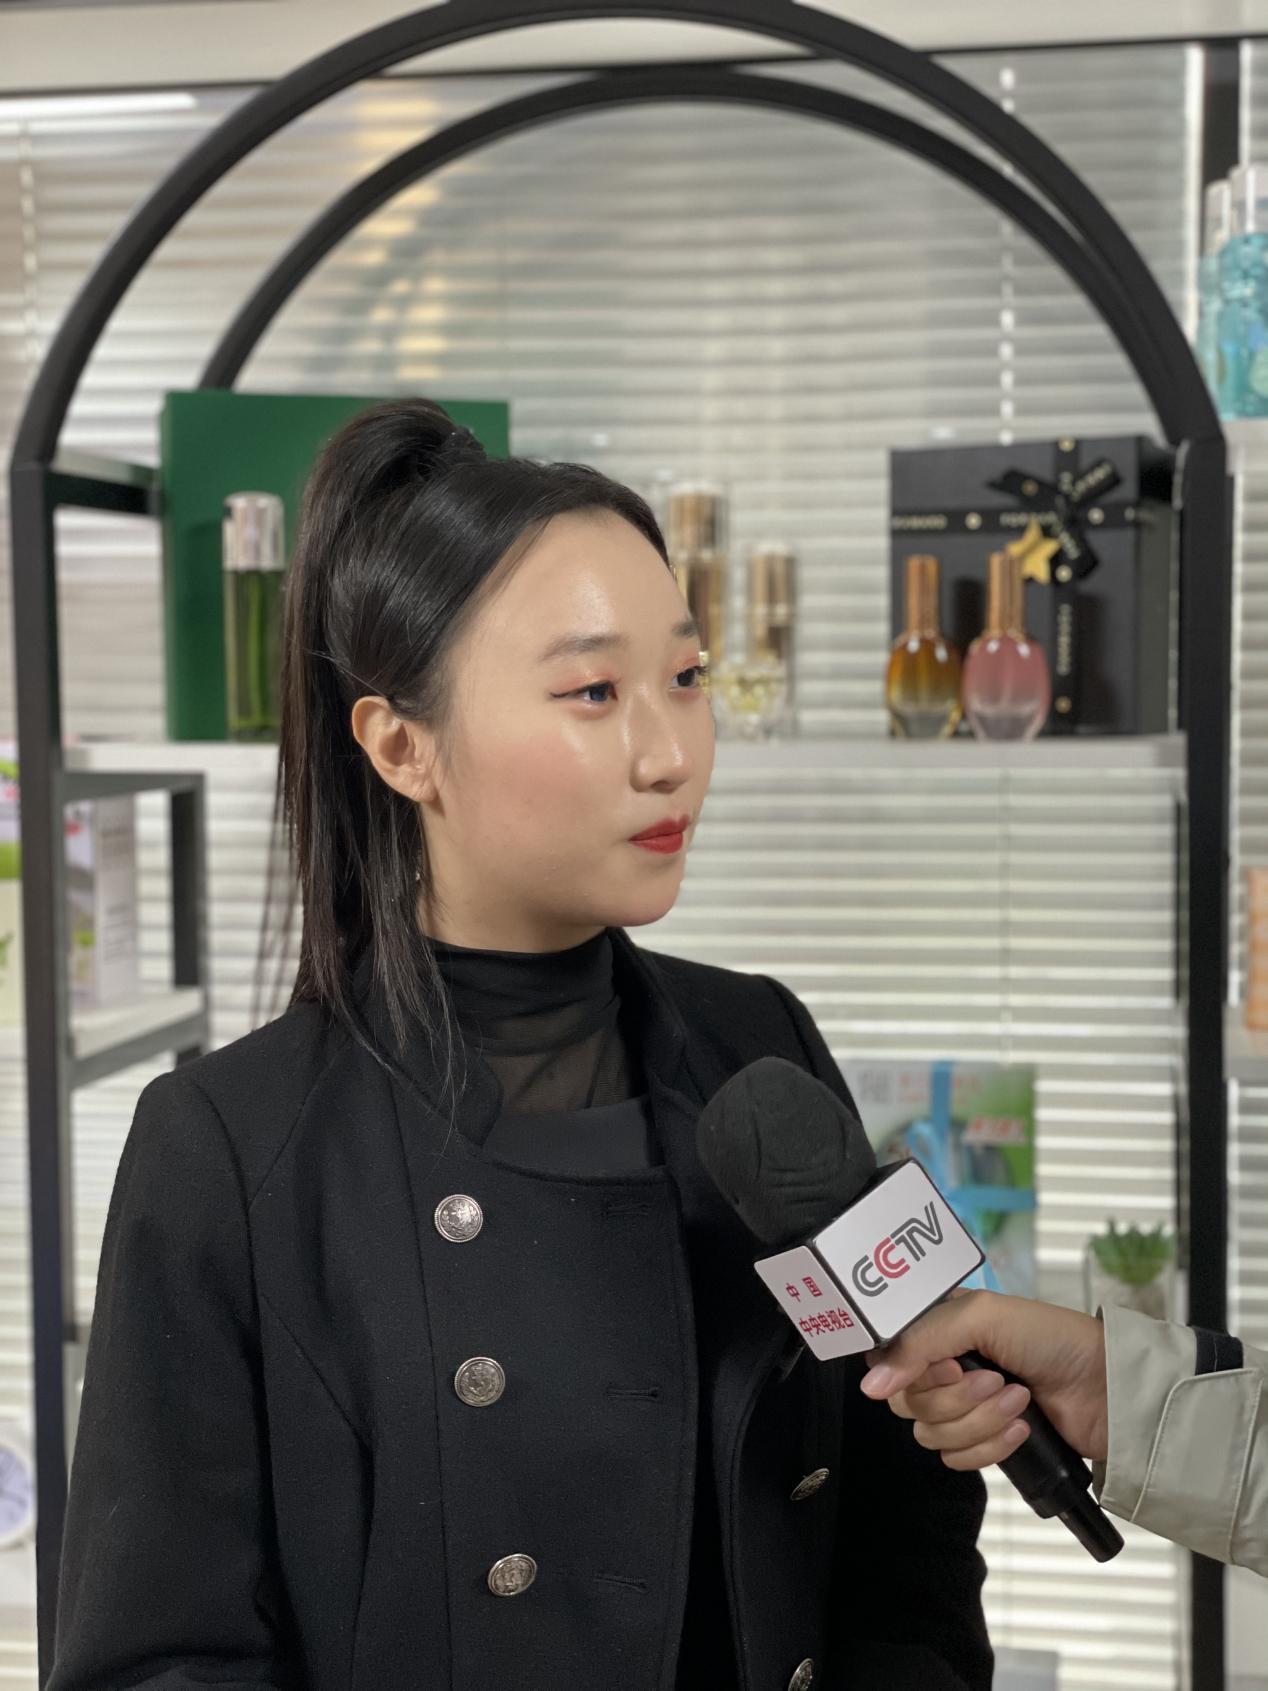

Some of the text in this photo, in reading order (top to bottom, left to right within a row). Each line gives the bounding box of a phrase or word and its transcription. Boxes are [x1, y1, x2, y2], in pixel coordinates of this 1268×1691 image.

[852, 1201, 943, 1297] CCTV
[799, 1307, 854, 1338] 中央电视台
